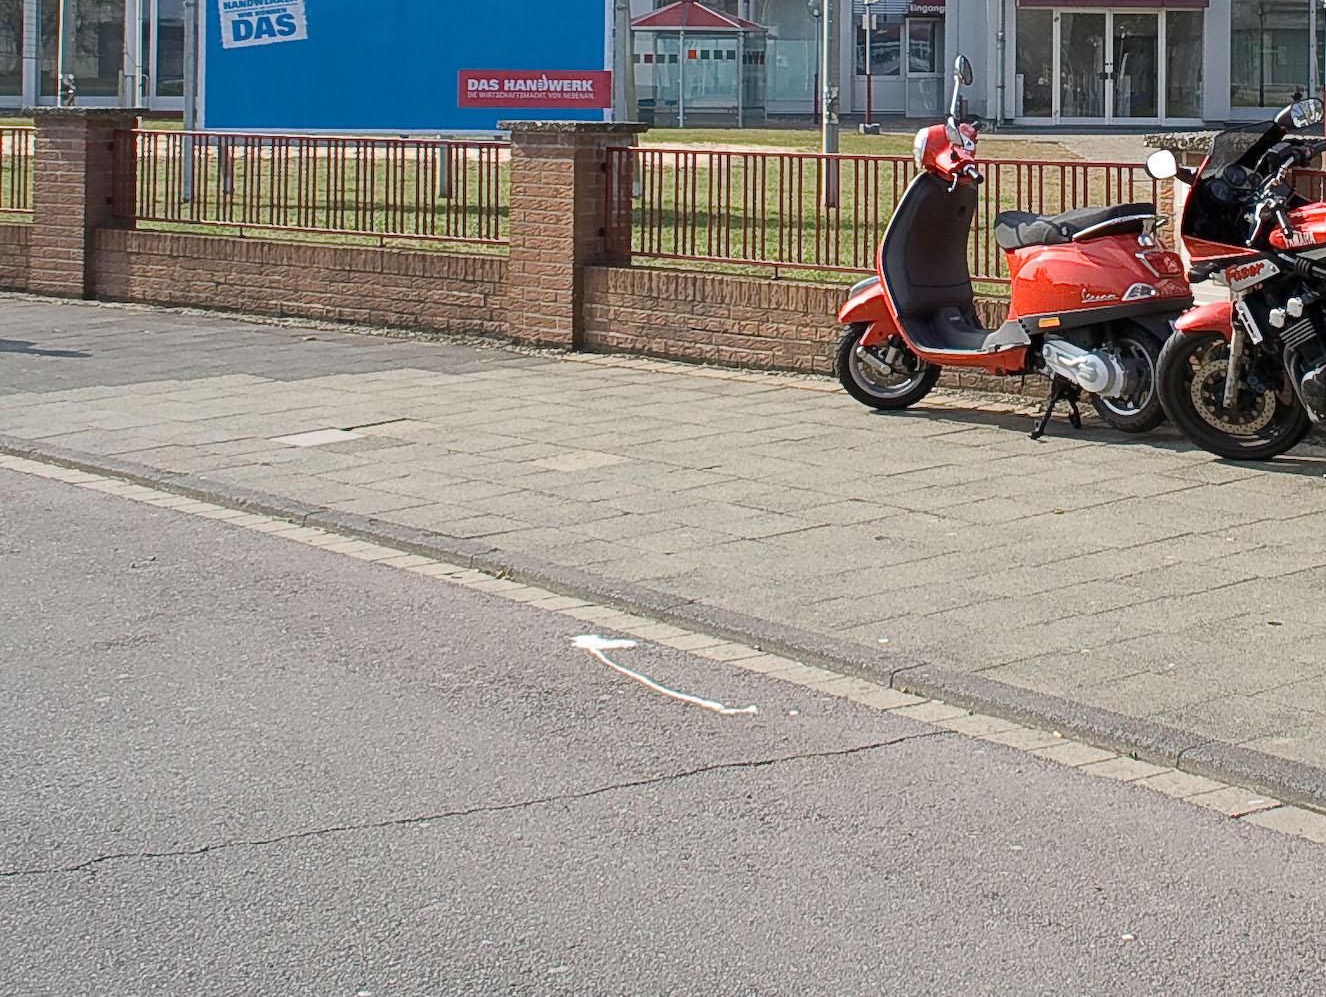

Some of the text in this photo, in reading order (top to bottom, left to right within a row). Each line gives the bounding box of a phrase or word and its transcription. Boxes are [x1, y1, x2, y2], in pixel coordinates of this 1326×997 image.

[909, 4, 945, 15] Eingang
[231, 13, 297, 42] DAS
[467, 74, 593, 92] DAS HANDWERK
